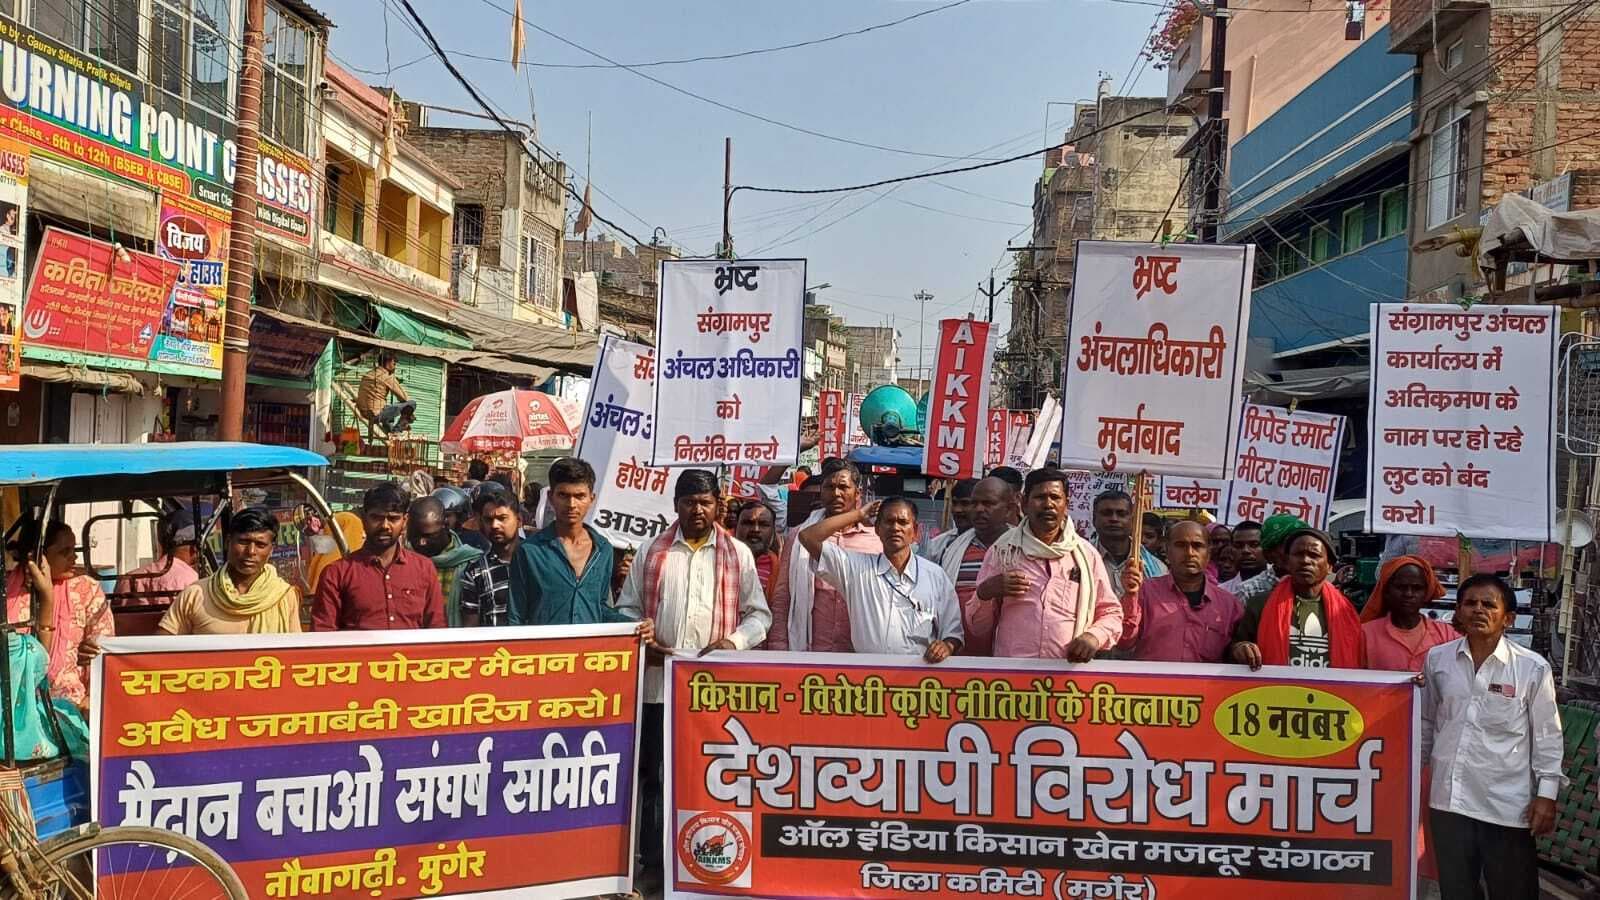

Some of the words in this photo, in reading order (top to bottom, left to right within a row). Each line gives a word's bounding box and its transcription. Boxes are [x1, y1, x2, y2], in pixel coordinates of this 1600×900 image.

[27, 35, 57, 57] Gaurav
[0, 40, 132, 146] URNING
[139, 102, 218, 177] POINT
[10, 117, 43, 140] Class
[52, 134, 71, 152] 6th
[73, 142, 84, 156] to
[87, 145, 111, 166] 12th
[112, 155, 144, 176] (BSEB
[156, 170, 184, 193] CBSE)
[198, 184, 220, 203] Smart
[167, 222, 207, 253] विजय
[43, 257, 108, 292] कविता
[189, 260, 224, 285] हाउस
[715, 265, 760, 297] भ्रष्ट
[1133, 255, 1181, 300] भ्रष्ट
[697, 306, 772, 343] संग्रामपुर
[1388, 306, 1485, 341] संग्रामपुर
[1486, 308, 1549, 334] अंचल
[663, 349, 716, 380] अंचल
[717, 348, 800, 379] अधिकारी
[1076, 321, 1227, 379] अंचलाधिकारी
[1386, 344, 1480, 371] कार्यालय
[1482, 346, 1503, 371] में
[590, 393, 644, 437] अंचल
[716, 393, 742, 420] को
[938, 322, 975, 476] AIKKMS
[1384, 382, 1491, 412] अतिक्रमण
[1494, 385, 1520, 411] के
[824, 393, 838, 458] AIKKM
[1097, 403, 1185, 472] मुर्दाबाद
[1244, 406, 1290, 445] प्रिपेड
[1291, 417, 1338, 451] स्मार्ट
[1383, 428, 1430, 448] नाम
[1432, 429, 1465, 448] पर
[1465, 423, 1491, 451] हो
[1493, 425, 1524, 453] रहे
[674, 434, 742, 463] निलंबित
[744, 435, 779, 462] करो
[616, 455, 652, 491] होश
[1237, 446, 1277, 486] मीटर
[1276, 460, 1331, 494] लगाना
[1382, 466, 1420, 494] लुट
[1421, 461, 1454, 487] को
[1456, 462, 1491, 488] बंद
[1166, 480, 1221, 506] चलेग
[1237, 487, 1269, 523] बंद
[593, 508, 670, 538] आओ
[120, 656, 285, 696] सरकारी
[291, 661, 362, 688] राय
[368, 651, 477, 683] पोखर
[479, 646, 580, 678] मैदान
[583, 650, 633, 673] का
[688, 671, 780, 713] किसान
[800, 674, 887, 718] विरोधी
[888, 677, 952, 729] कृषि
[954, 677, 1053, 722] नीतियों
[1053, 681, 1086, 723] के
[1228, 701, 1261, 738] 18
[1267, 692, 1350, 743] नवंबर
[117, 708, 231, 748] अवैध
[236, 697, 402, 738] जमाबंदी
[407, 692, 533, 730] खारिज
[702, 716, 999, 816] देशव्यापी
[1009, 724, 1215, 826] विरोध
[1224, 738, 1384, 834] मार्च
[118, 760, 244, 865] मैदान
[255, 744, 385, 837] बचाओ
[395, 736, 495, 824] संघर्ष
[502, 730, 622, 815] समिति
[779, 819, 852, 848] ऑल
[854, 820, 949, 852] इंडिया
[954, 823, 1067, 858] किसान
[1071, 831, 1139, 861] खेत
[1142, 839, 1255, 876] मजदूर
[1257, 840, 1375, 872] संगठन
[418, 841, 487, 896] मुंगेर
[860, 862, 941, 891] जिला
[946, 867, 1046, 896] कमिटी
